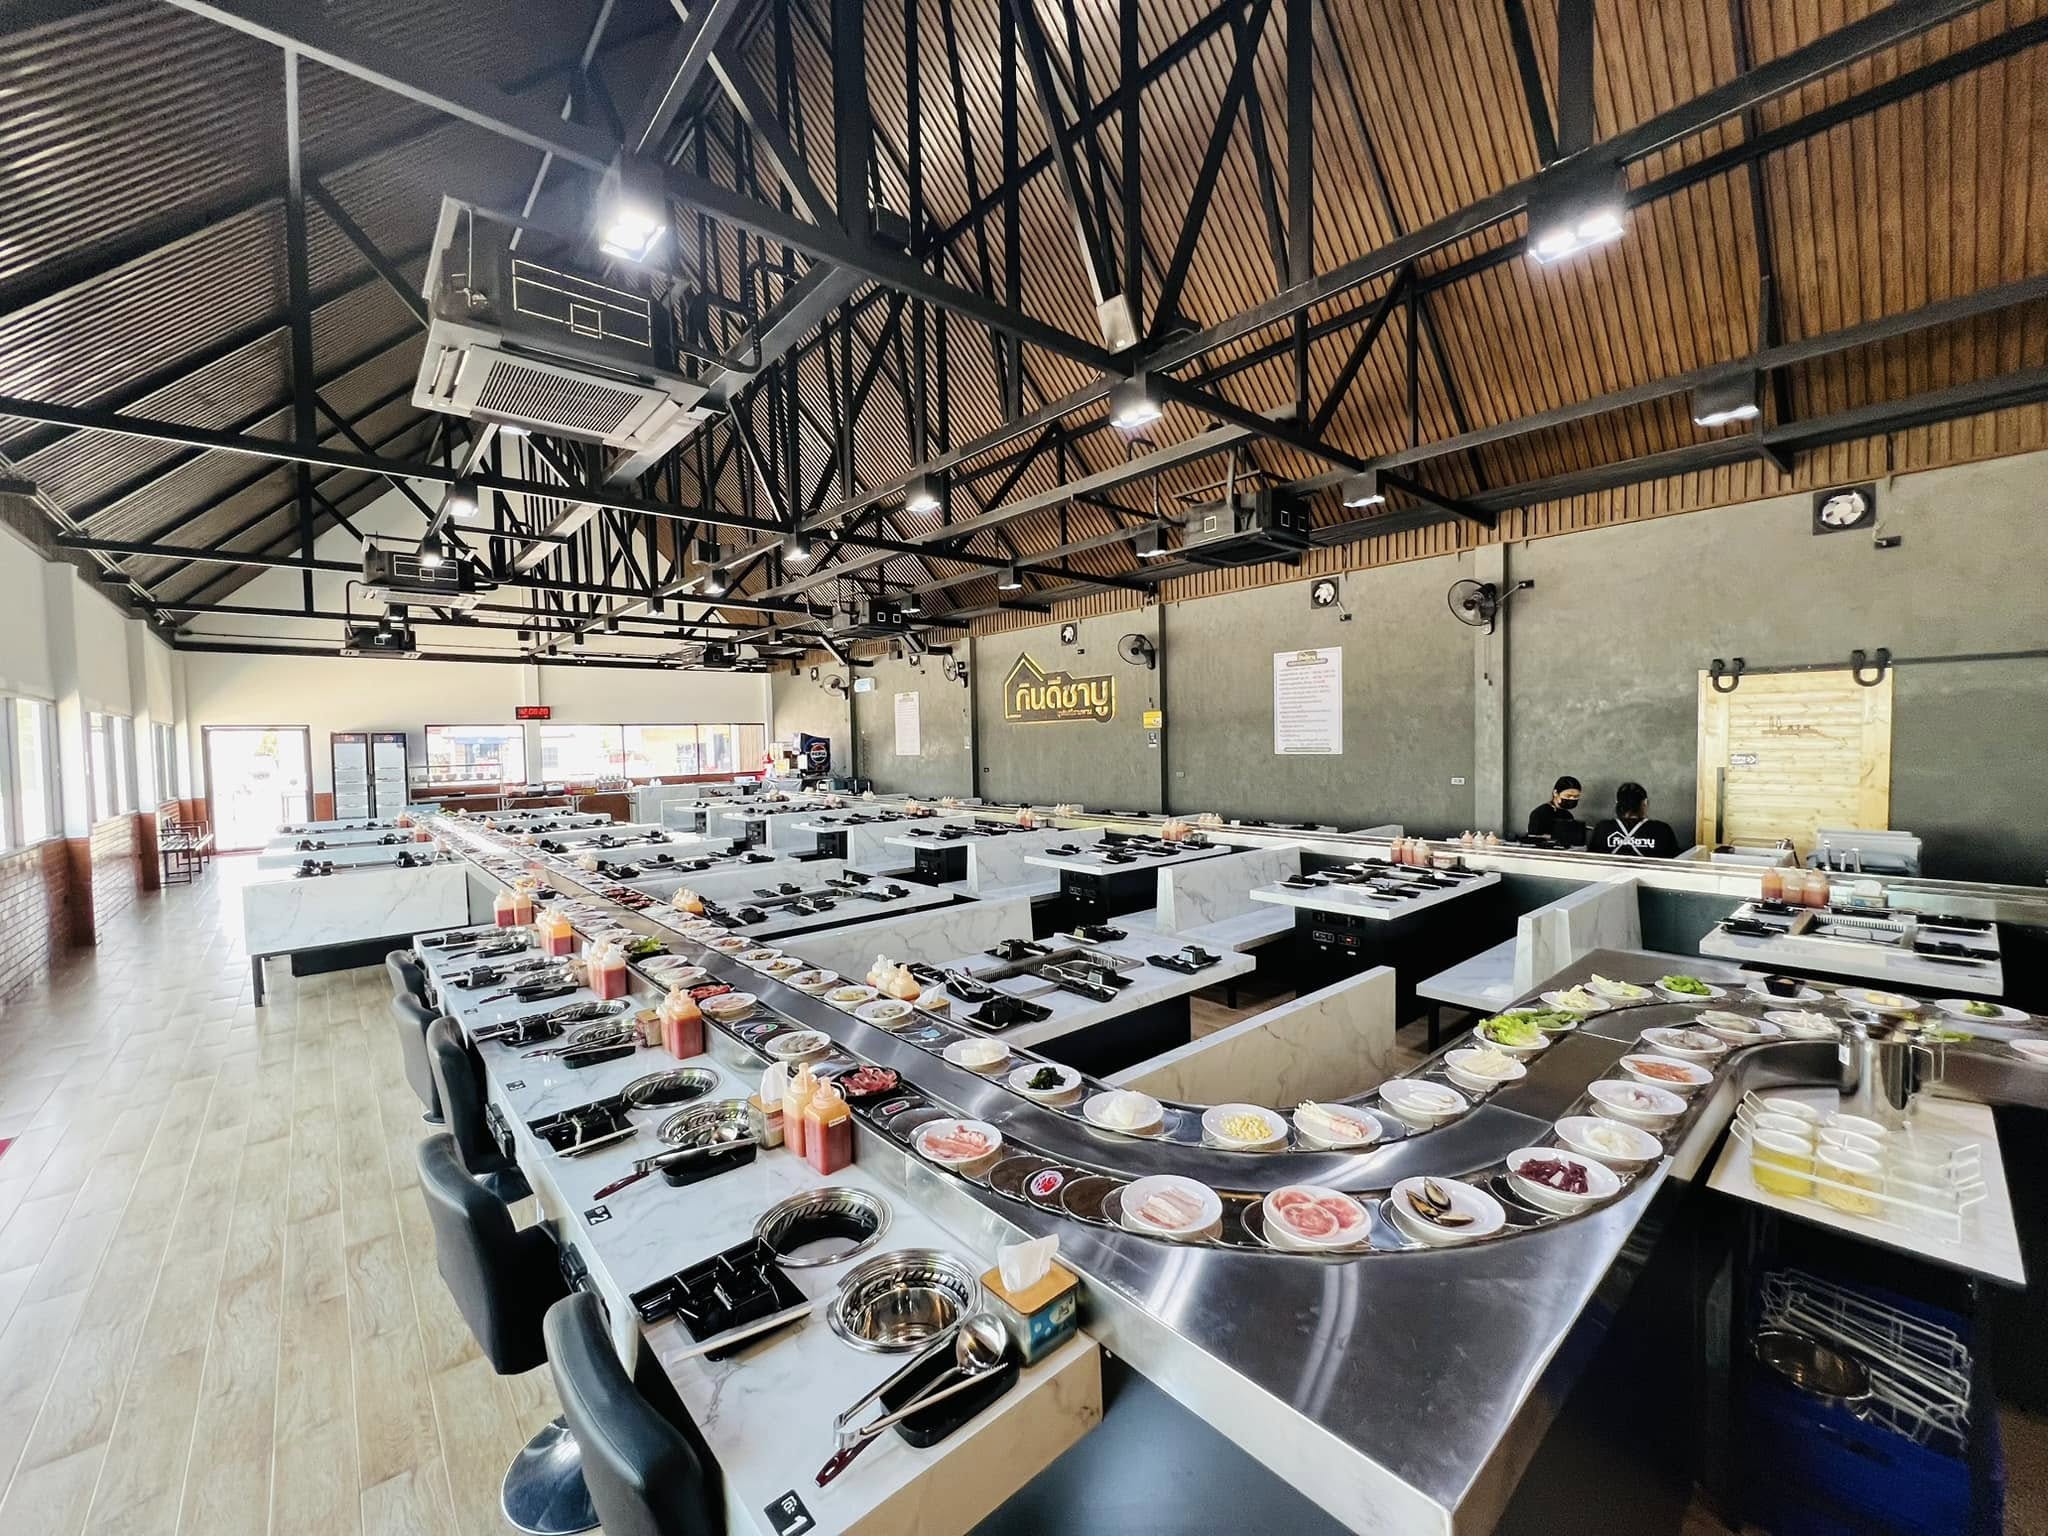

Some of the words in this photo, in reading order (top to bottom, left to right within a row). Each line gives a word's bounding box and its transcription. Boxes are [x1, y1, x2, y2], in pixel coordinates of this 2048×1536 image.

[1015, 676, 1109, 716] กินดีชาบู
[590, 1213, 609, 1225] 2
[782, 1515, 807, 1536] 1
